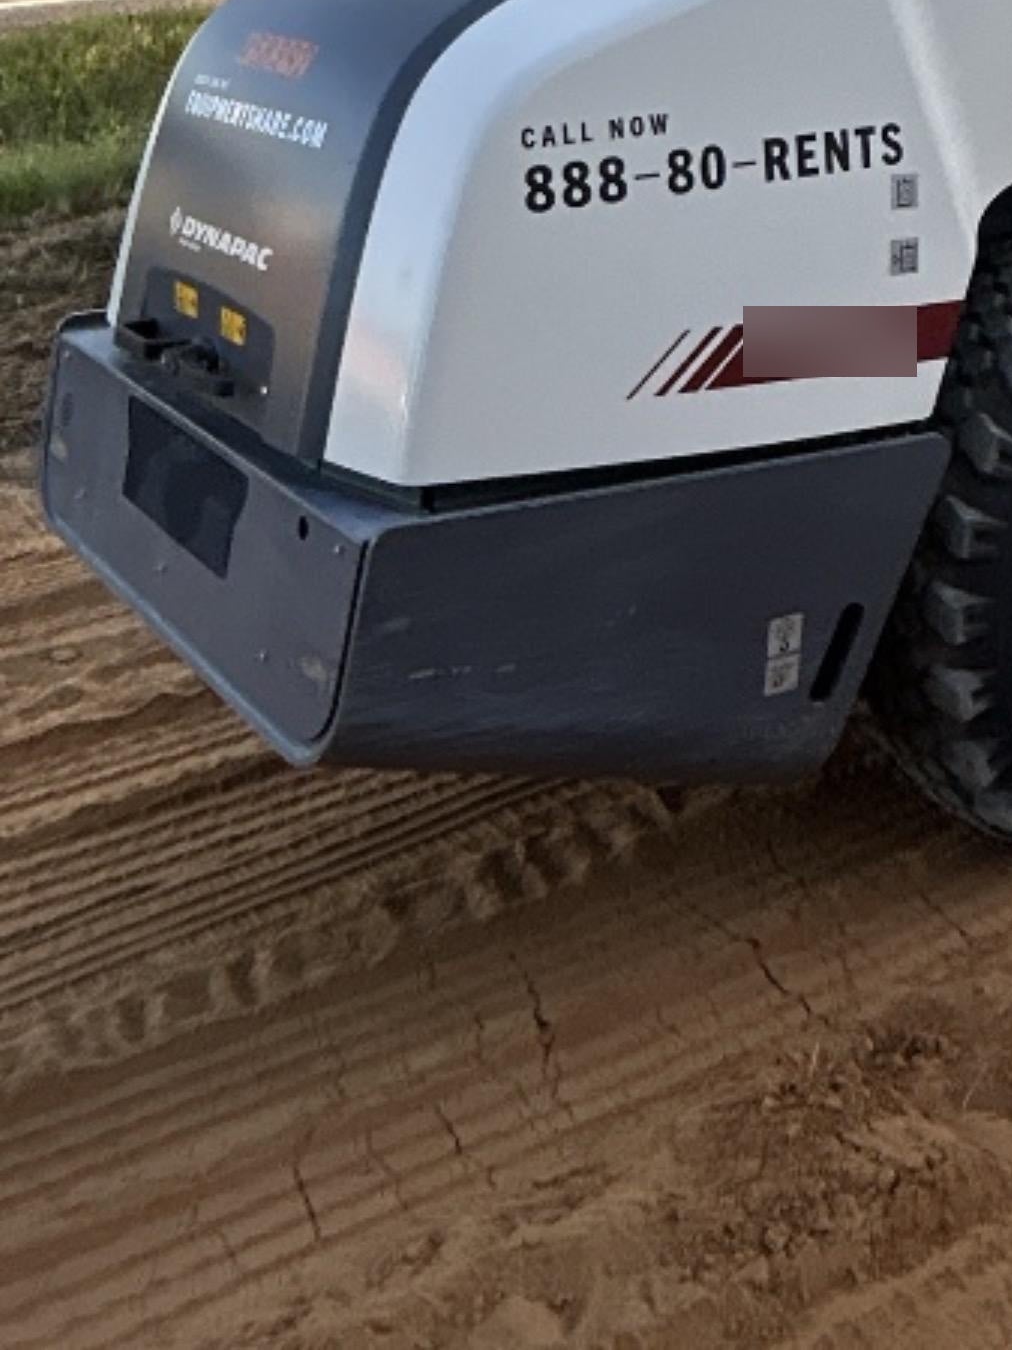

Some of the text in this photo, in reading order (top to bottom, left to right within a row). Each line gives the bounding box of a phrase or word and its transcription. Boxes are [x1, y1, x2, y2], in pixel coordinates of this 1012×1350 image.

[521, 113, 670, 150] CALL NOW
[523, 122, 905, 214] 888-80-RENTS
[181, 215, 274, 271] DYNAPAC
